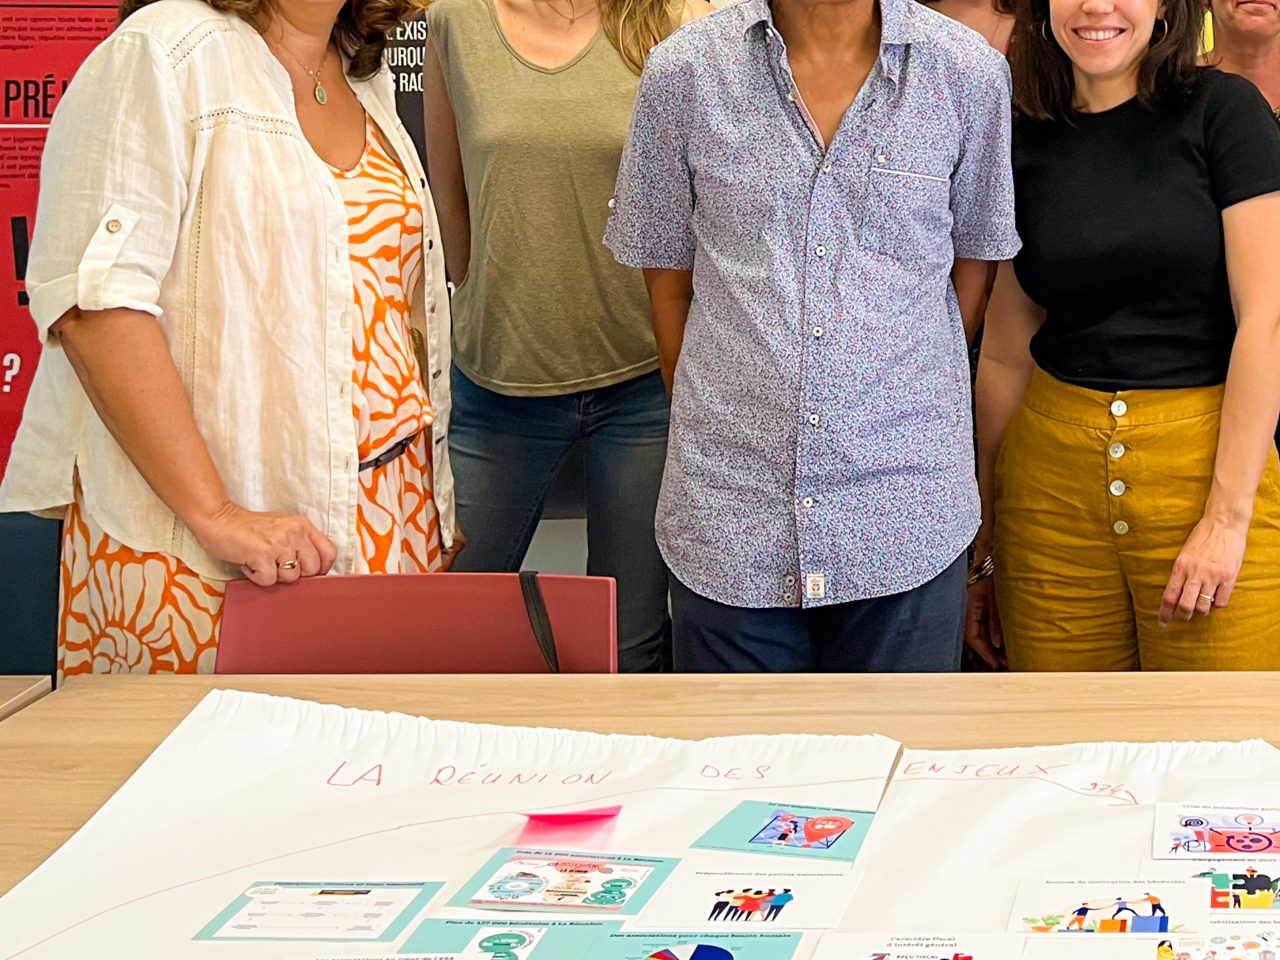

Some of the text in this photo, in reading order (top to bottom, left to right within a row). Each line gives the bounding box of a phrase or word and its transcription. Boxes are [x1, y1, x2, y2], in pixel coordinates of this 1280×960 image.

[4, 74, 72, 119] PRÉ
[326, 760, 384, 788] LA
[699, 763, 772, 781] DES
